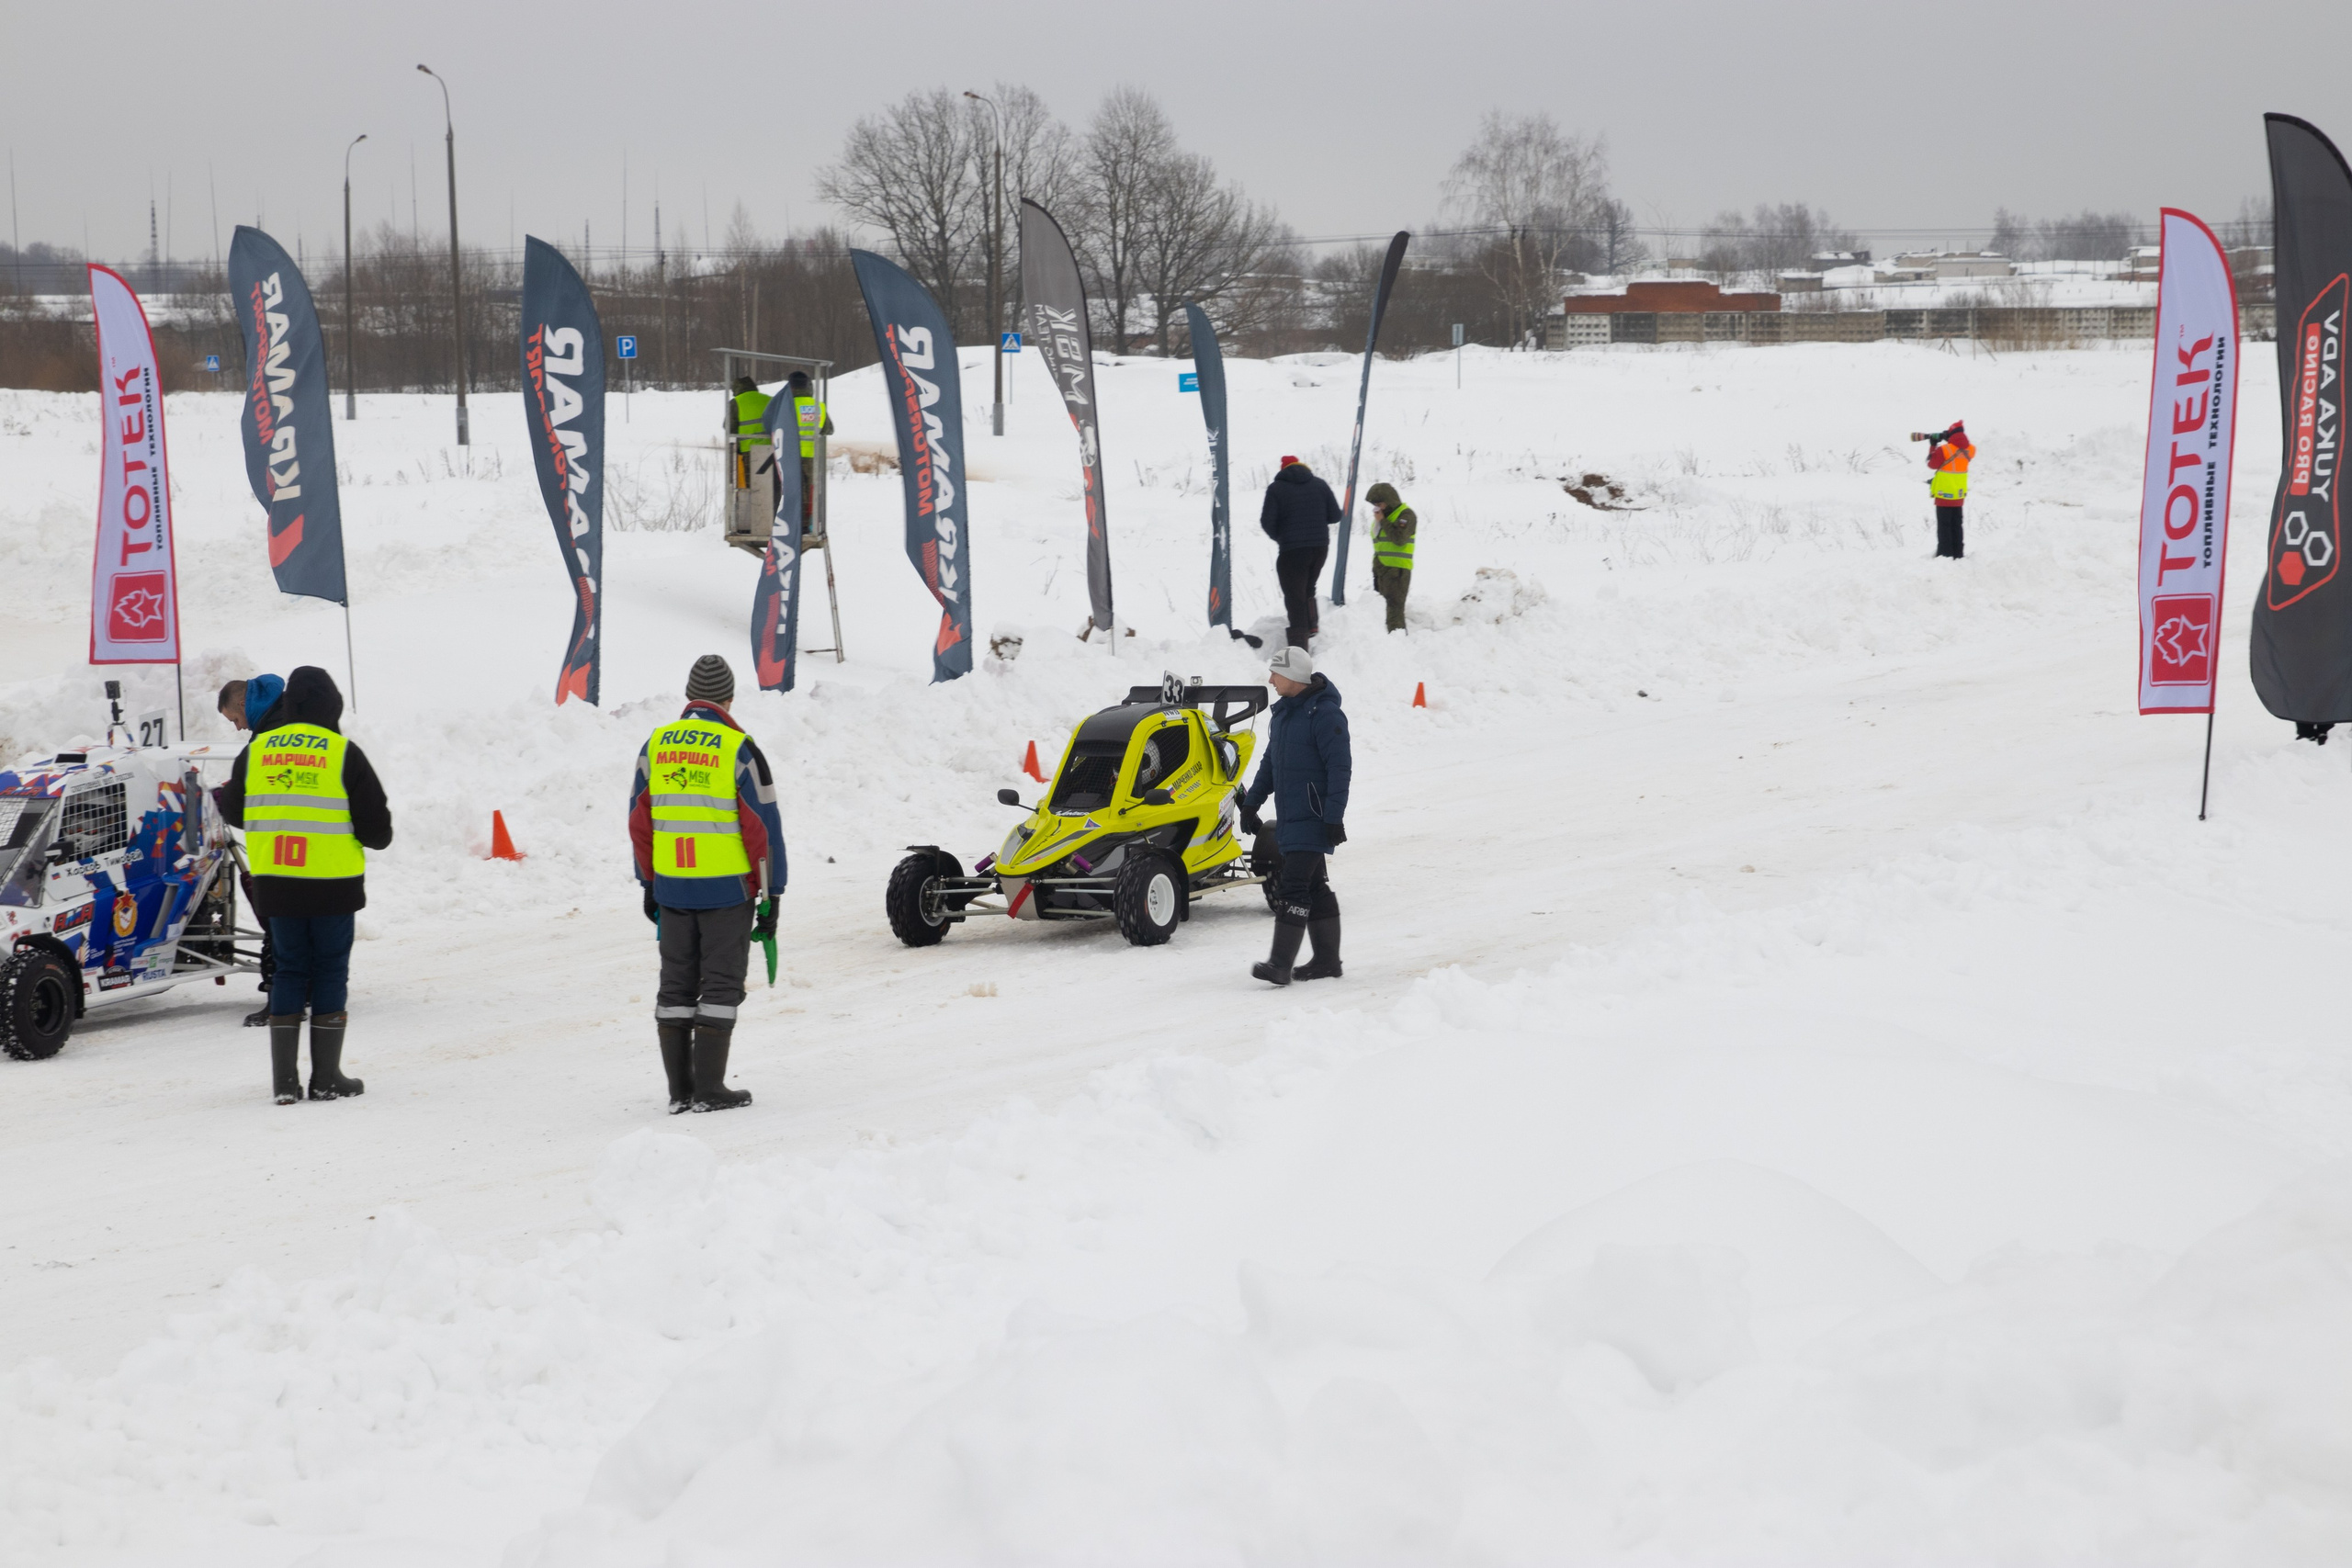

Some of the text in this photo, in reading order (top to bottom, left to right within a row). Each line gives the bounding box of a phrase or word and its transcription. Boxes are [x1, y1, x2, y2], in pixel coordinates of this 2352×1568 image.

[622, 339, 633, 355] P
[143, 367, 164, 550] ТОПЛИВНЫЕ ТЕХНОЛОГИИ
[2203, 336, 2225, 569] ТОПЛИВНЫЕ ТЕХНОЛОГИИ
[1164, 675, 1183, 704] 33
[141, 718, 164, 747] 27
[266, 734, 328, 750] RUSTA
[660, 729, 722, 749] RUSTA
[262, 753, 327, 769] МАРШАЛ
[656, 750, 719, 768] МАРШАЛ
[689, 770, 711, 784] MSK
[274, 835, 307, 867] 10
[675, 837, 695, 868] 11
[142, 969, 166, 981] RUSTA
